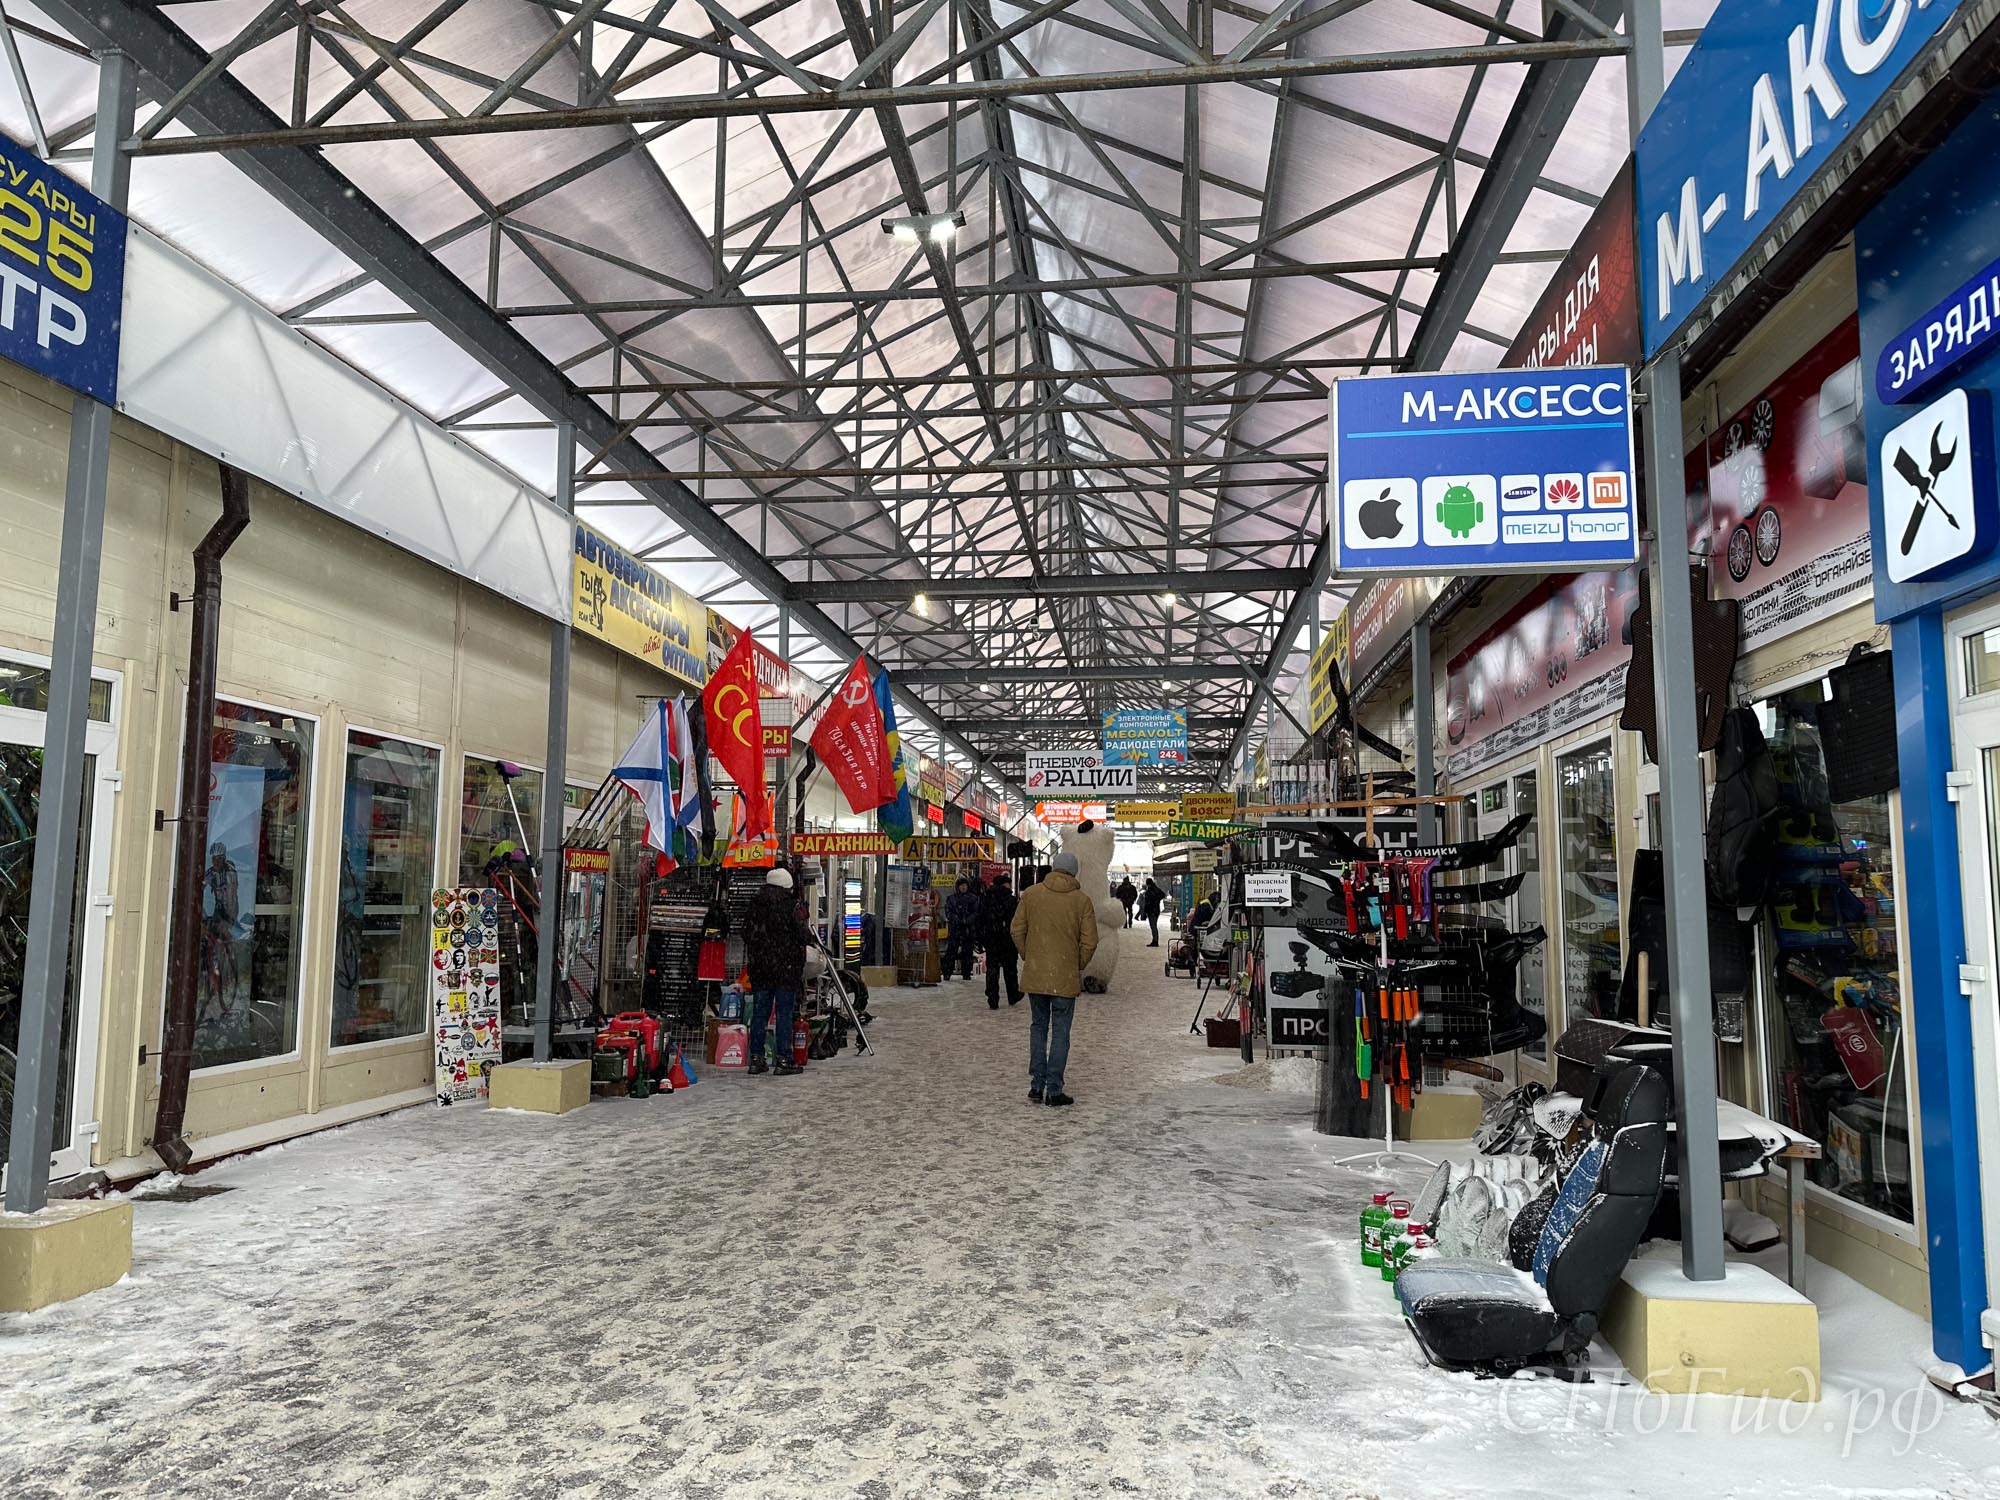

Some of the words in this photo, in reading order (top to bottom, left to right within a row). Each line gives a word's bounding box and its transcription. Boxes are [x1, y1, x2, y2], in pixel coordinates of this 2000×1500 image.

[1564, 254, 1600, 345] ДЛЯ
[1401, 383, 1623, 423] М-АКСЕСС
[1507, 488, 1535, 497] SAMSUNG
[1506, 522, 1560, 536] MEIZU
[1570, 519, 1626, 534] honor
[575, 525, 672, 612] АВТОЗЕРКАЛА
[580, 570, 593, 594] ТЫ
[609, 579, 690, 649] АКСЕССУАРЫ
[1743, 595, 1780, 623] КОЛПАКИ
[1354, 603, 1384, 660] СЕРВИСНЫЙ
[1384, 582, 1404, 625] ЦЕНТР
[661, 639, 706, 686] ОПТИКА
[1118, 714, 1172, 722] ЭЛЕКТРОННЫЕ
[763, 729, 787, 745] РЫ
[1106, 728, 1183, 739] MEGAVOLT
[1105, 740, 1185, 750] РАДИОДЕТАЛИ
[1159, 750, 1178, 759] 242
[1044, 768, 1134, 790] РАЦИИ
[1186, 797, 1232, 806] ДВОРНИКИ
[793, 835, 896, 852] БАГАЖНИКИ
